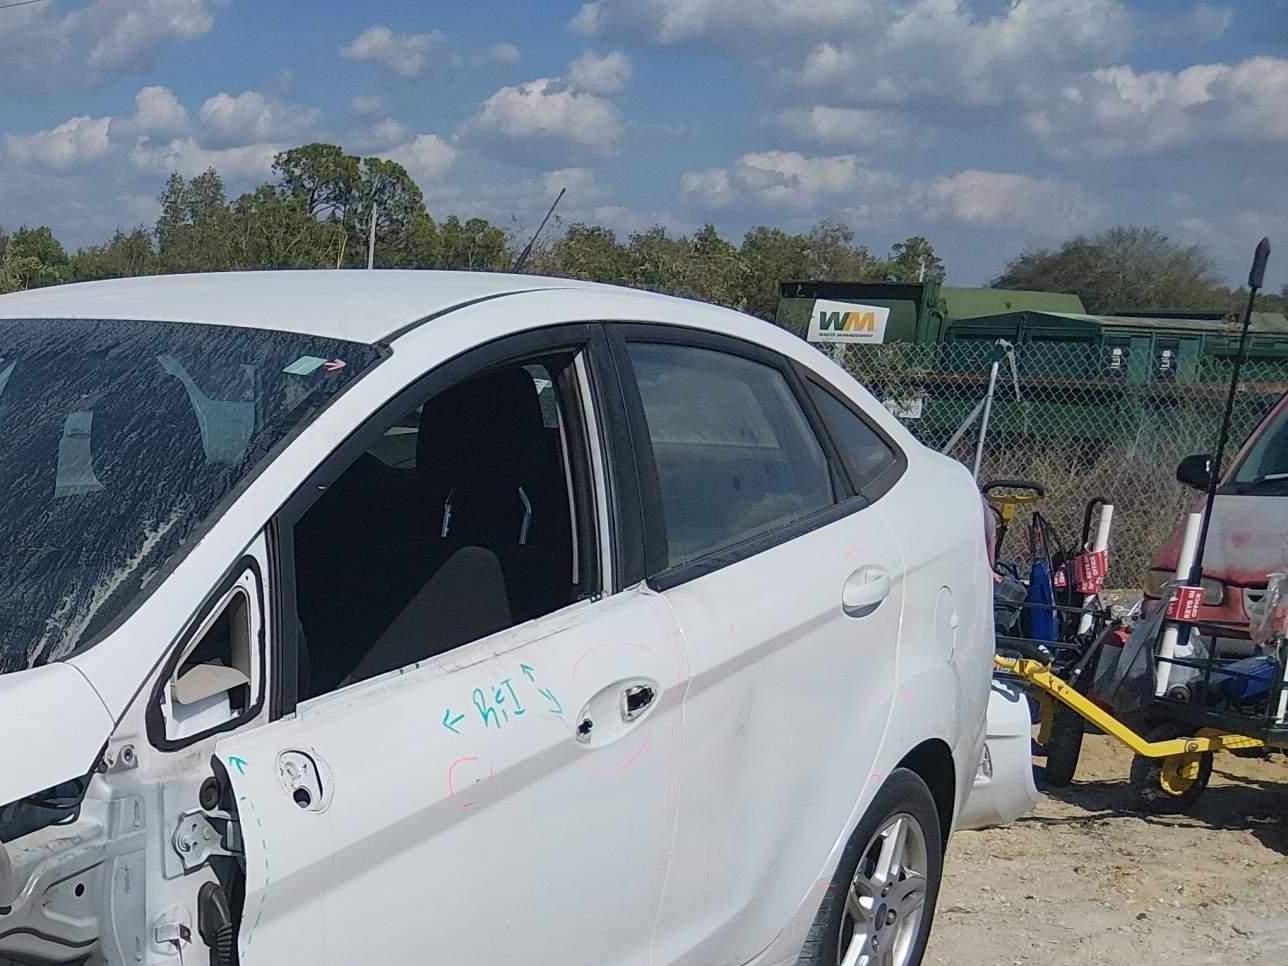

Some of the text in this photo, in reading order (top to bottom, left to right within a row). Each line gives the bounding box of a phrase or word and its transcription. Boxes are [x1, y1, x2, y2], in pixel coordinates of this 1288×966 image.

[819, 311, 875, 331] WM
[1183, 599, 1194, 619] KEYS
[1191, 592, 1202, 618] OFFICE
